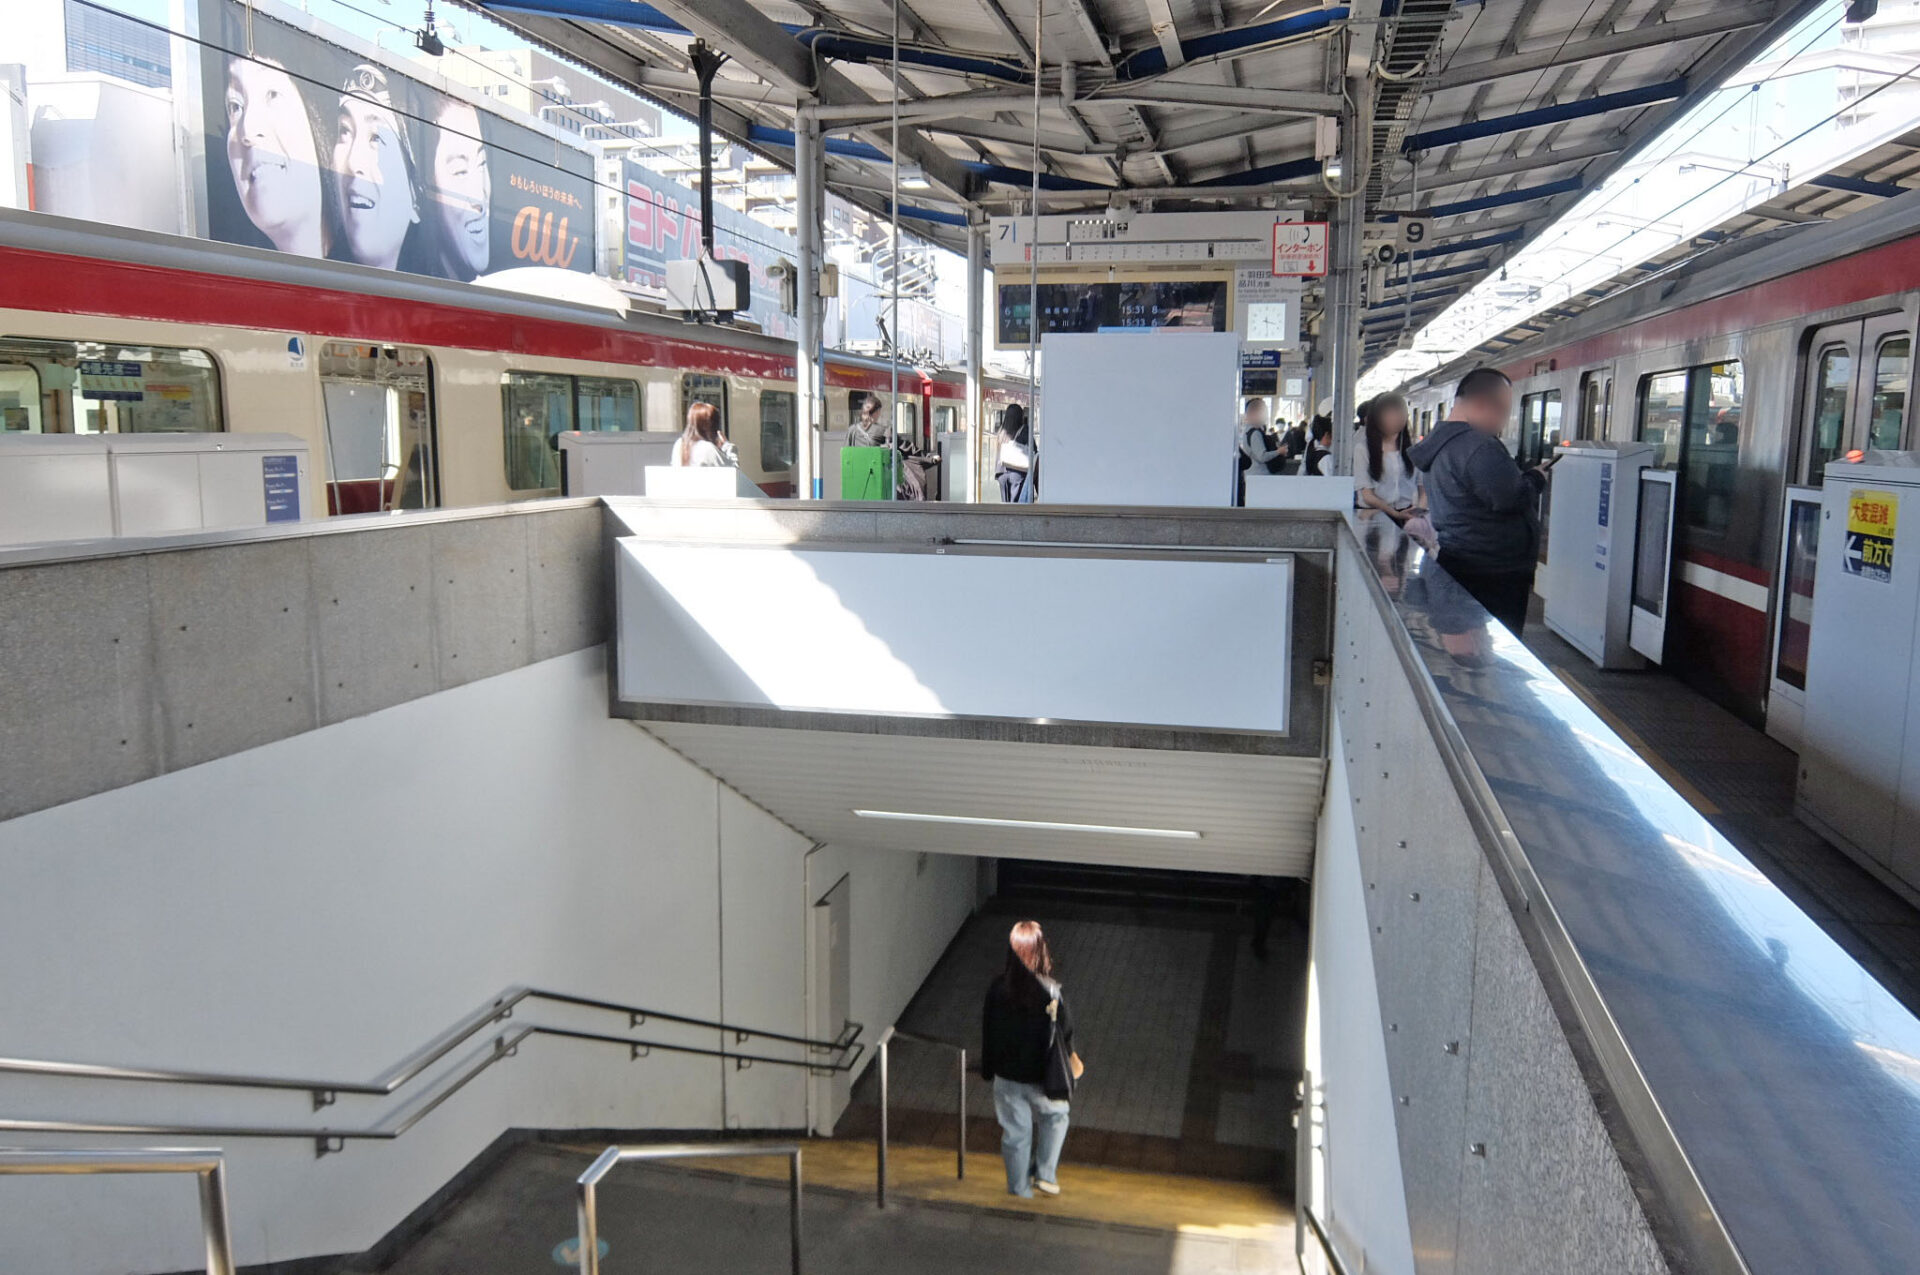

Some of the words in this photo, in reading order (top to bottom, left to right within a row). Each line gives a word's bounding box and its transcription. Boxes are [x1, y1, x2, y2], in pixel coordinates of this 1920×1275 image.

[511, 205, 579, 268] au
[999, 224, 1010, 241] 7
[1406, 222, 1425, 243] 9
[1277, 243, 1324, 253] インターホン
